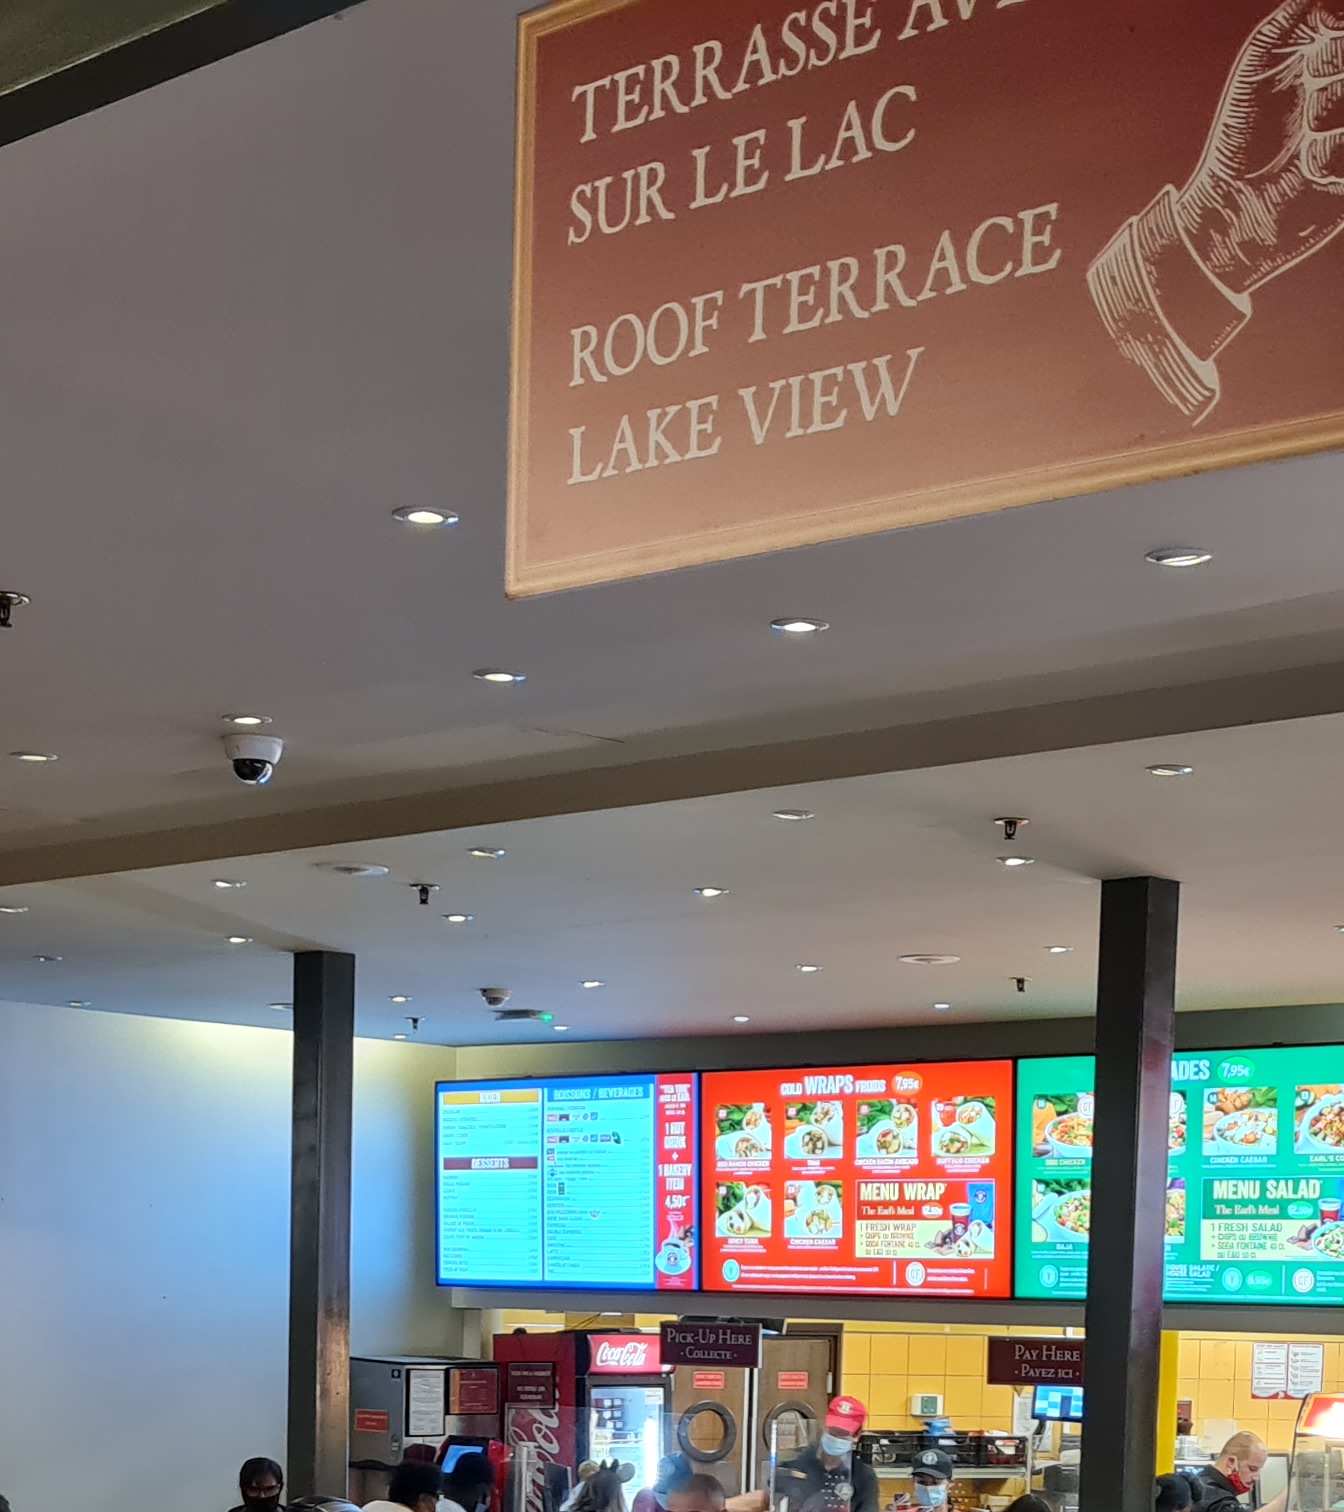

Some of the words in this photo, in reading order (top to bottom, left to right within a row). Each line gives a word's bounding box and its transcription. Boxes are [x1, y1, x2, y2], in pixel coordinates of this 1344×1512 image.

[571, 0, 884, 144] TERRASSE
[567, 161, 675, 245] SUR
[688, 128, 769, 210] LE
[783, 84, 917, 182] LAC
[569, 291, 723, 388] ROOF
[737, 202, 1060, 343] TERRACE
[567, 394, 721, 485] LAKE
[737, 346, 926, 446] VIEW
[780, 1082, 803, 1096] COLD
[804, 1075, 854, 1095] WRAPS
[855, 1079, 886, 1094] FROIDS
[860, 1183, 899, 1201] MENU
[1213, 1181, 1260, 1200] MENU
[1266, 1180, 1321, 1199] SALAD
[866, 1223, 890, 1232] FRESH
[896, 1223, 916, 1232] WRAP
[1218, 1223, 1248, 1232] FRESH
[1252, 1223, 1283, 1232] SALAD
[667, 1328, 717, 1345] PICK-UP
[718, 1330, 752, 1345] HERE
[685, 1347, 732, 1360] COLLECTE
[1015, 1344, 1039, 1361] PAY
[1042, 1345, 1080, 1361] HERE
[1021, 1363, 1055, 1378] PAYEZ
